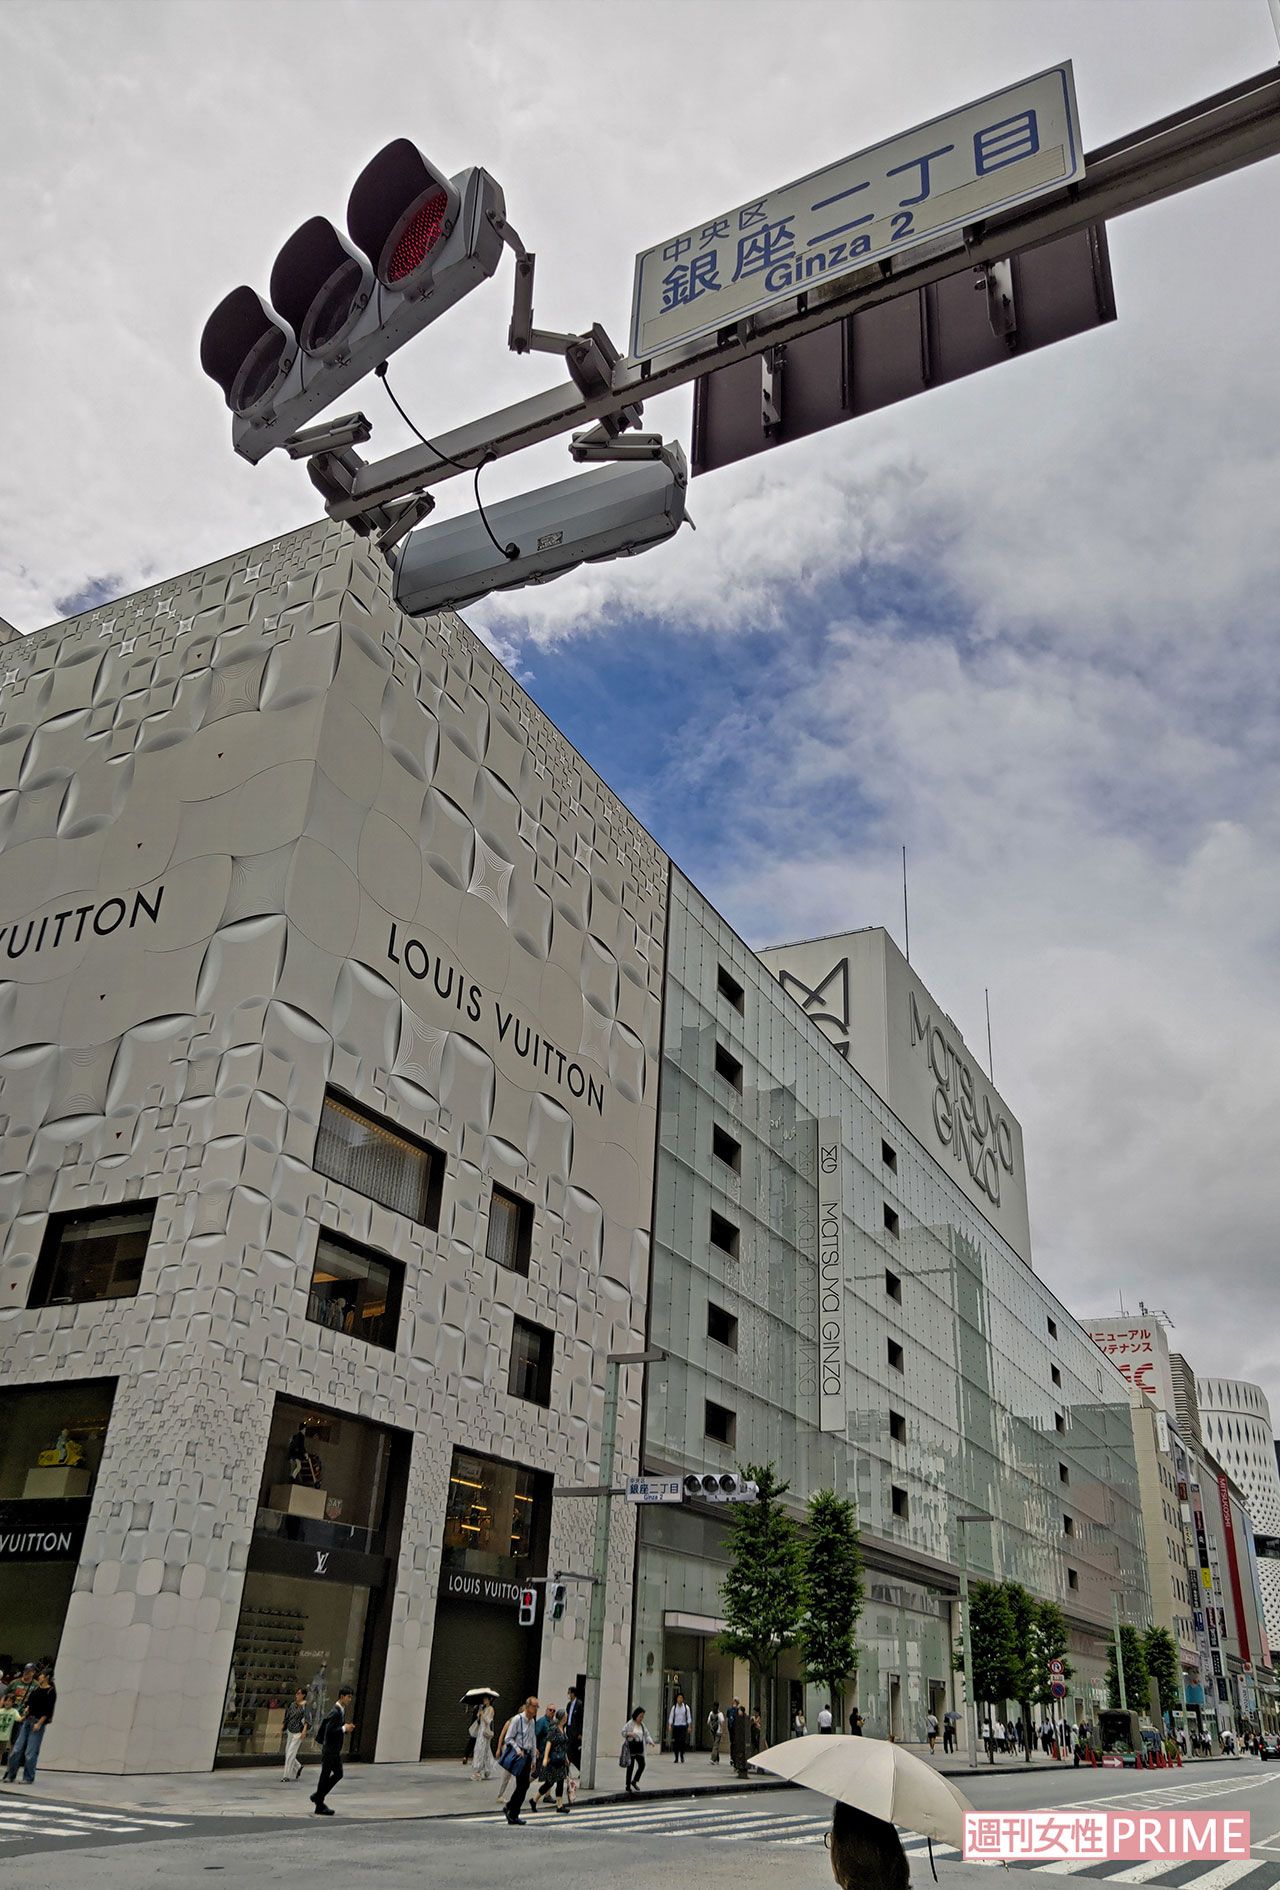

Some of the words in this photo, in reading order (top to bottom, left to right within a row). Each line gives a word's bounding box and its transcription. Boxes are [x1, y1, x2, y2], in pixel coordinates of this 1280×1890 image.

[660, 109, 1039, 315] 銀座二丁目
[662, 199, 769, 262] 中央区
[764, 233, 872, 293] Ginza
[890, 210, 916, 243] 2
[387, 921, 483, 1022] LOUIS
[495, 1001, 604, 1117] VUITTON
[630, 1483, 679, 1495] 銀座二丁目
[1219, 1477, 1231, 1527] MITSUKOSHI
[449, 1575, 480, 1595] LOUIS
[484, 1580, 523, 1600] VUITTO
